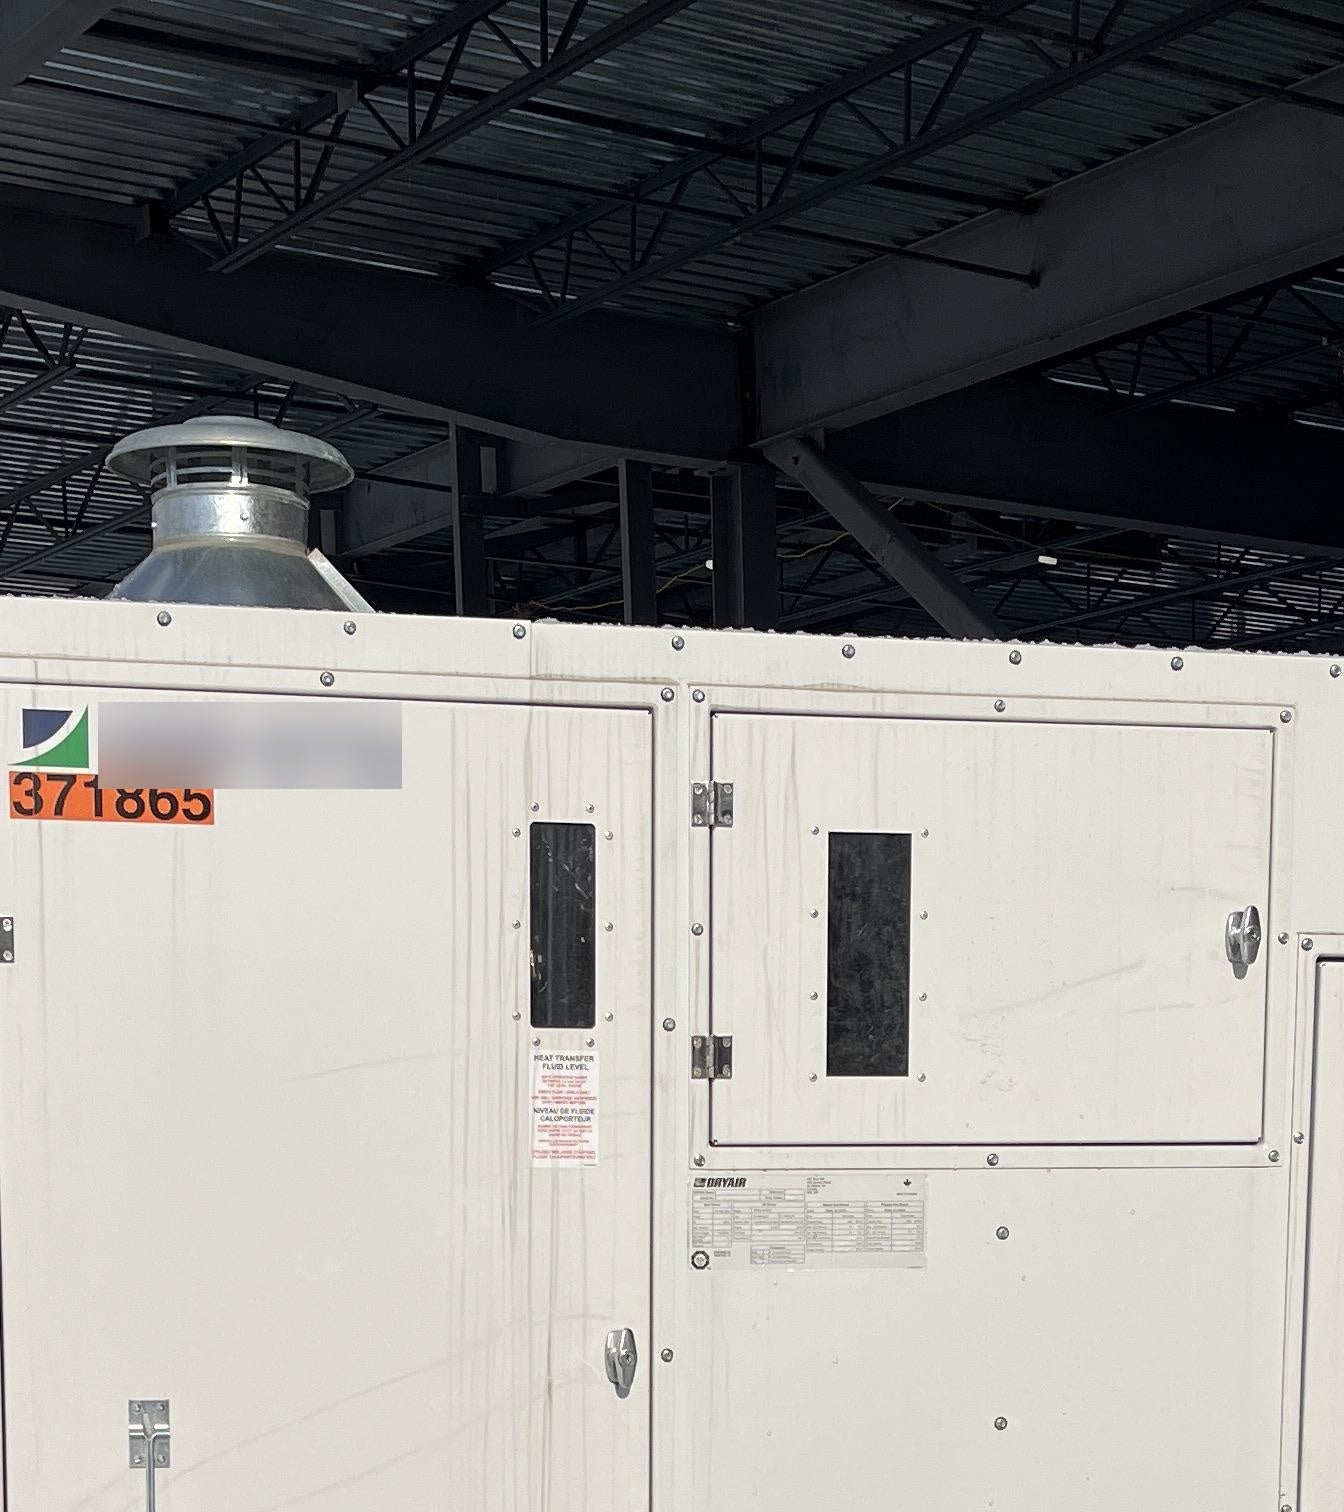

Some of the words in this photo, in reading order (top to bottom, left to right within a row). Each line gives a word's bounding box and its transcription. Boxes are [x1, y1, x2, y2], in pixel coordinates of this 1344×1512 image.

[12, 771, 212, 822] 371865
[555, 1055, 594, 1063] TRANSFER
[706, 1177, 748, 1188] DRYAIR
